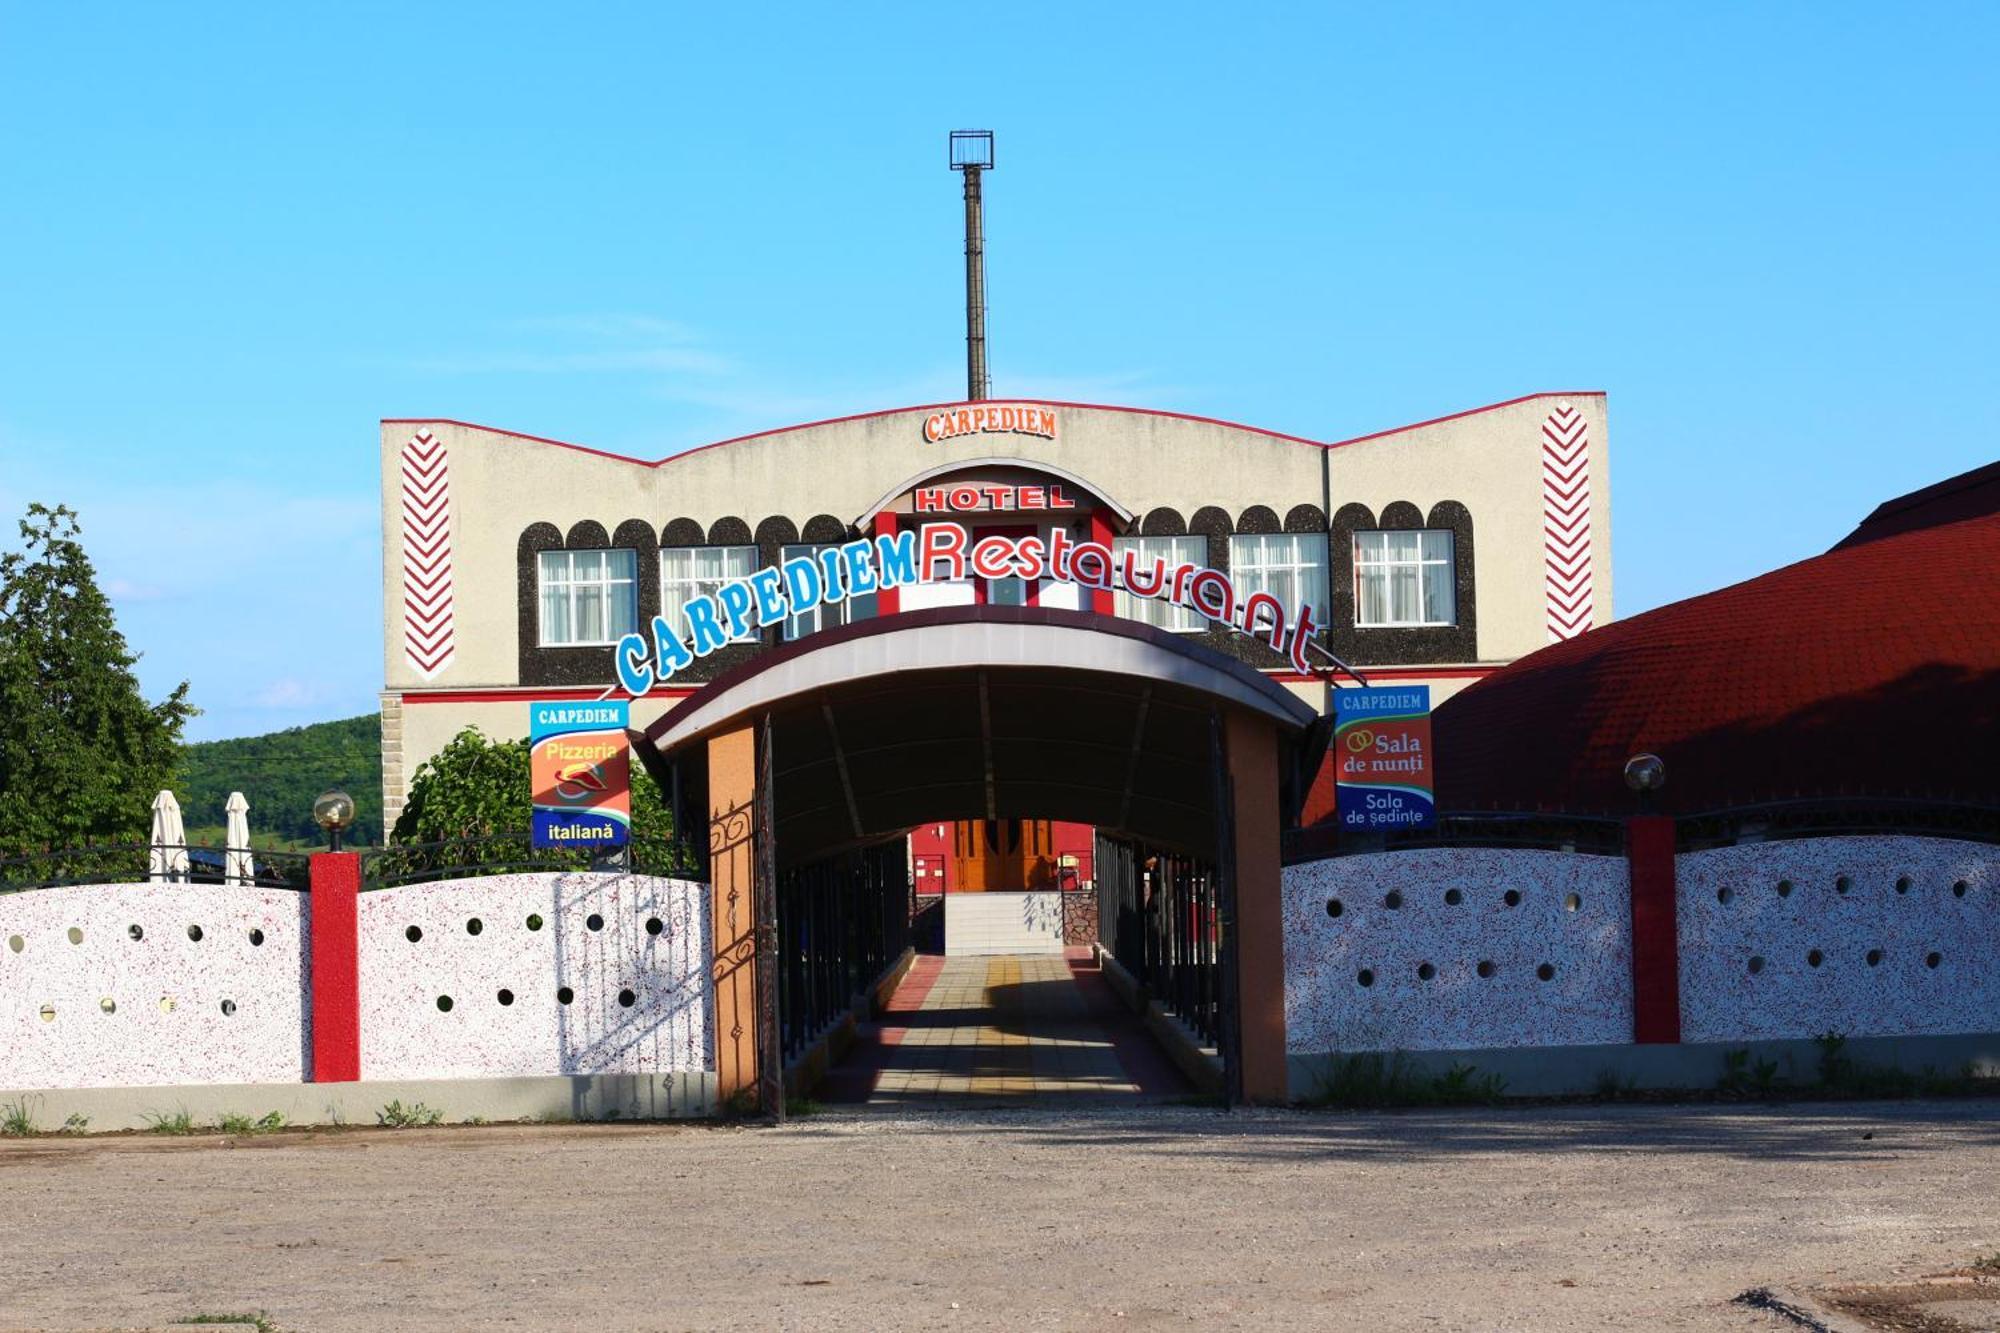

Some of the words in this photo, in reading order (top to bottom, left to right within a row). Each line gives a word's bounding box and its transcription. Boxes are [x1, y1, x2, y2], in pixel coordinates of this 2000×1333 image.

[925, 406, 1057, 442] CARPEDIEM
[915, 486, 1075, 511] HOTEL
[615, 530, 916, 696] CARPEDIEM
[918, 521, 1318, 676] Restaurant
[1343, 695, 1421, 709] CARPEDIEM
[539, 709, 619, 724] CARPEDIEM
[1375, 733, 1421, 753] Sala
[547, 743, 617, 760] Pizzeria
[1343, 757, 1366, 772] de
[1366, 793, 1403, 809] Sala
[1346, 809, 1365, 824] de
[549, 824, 613, 839] italiană
